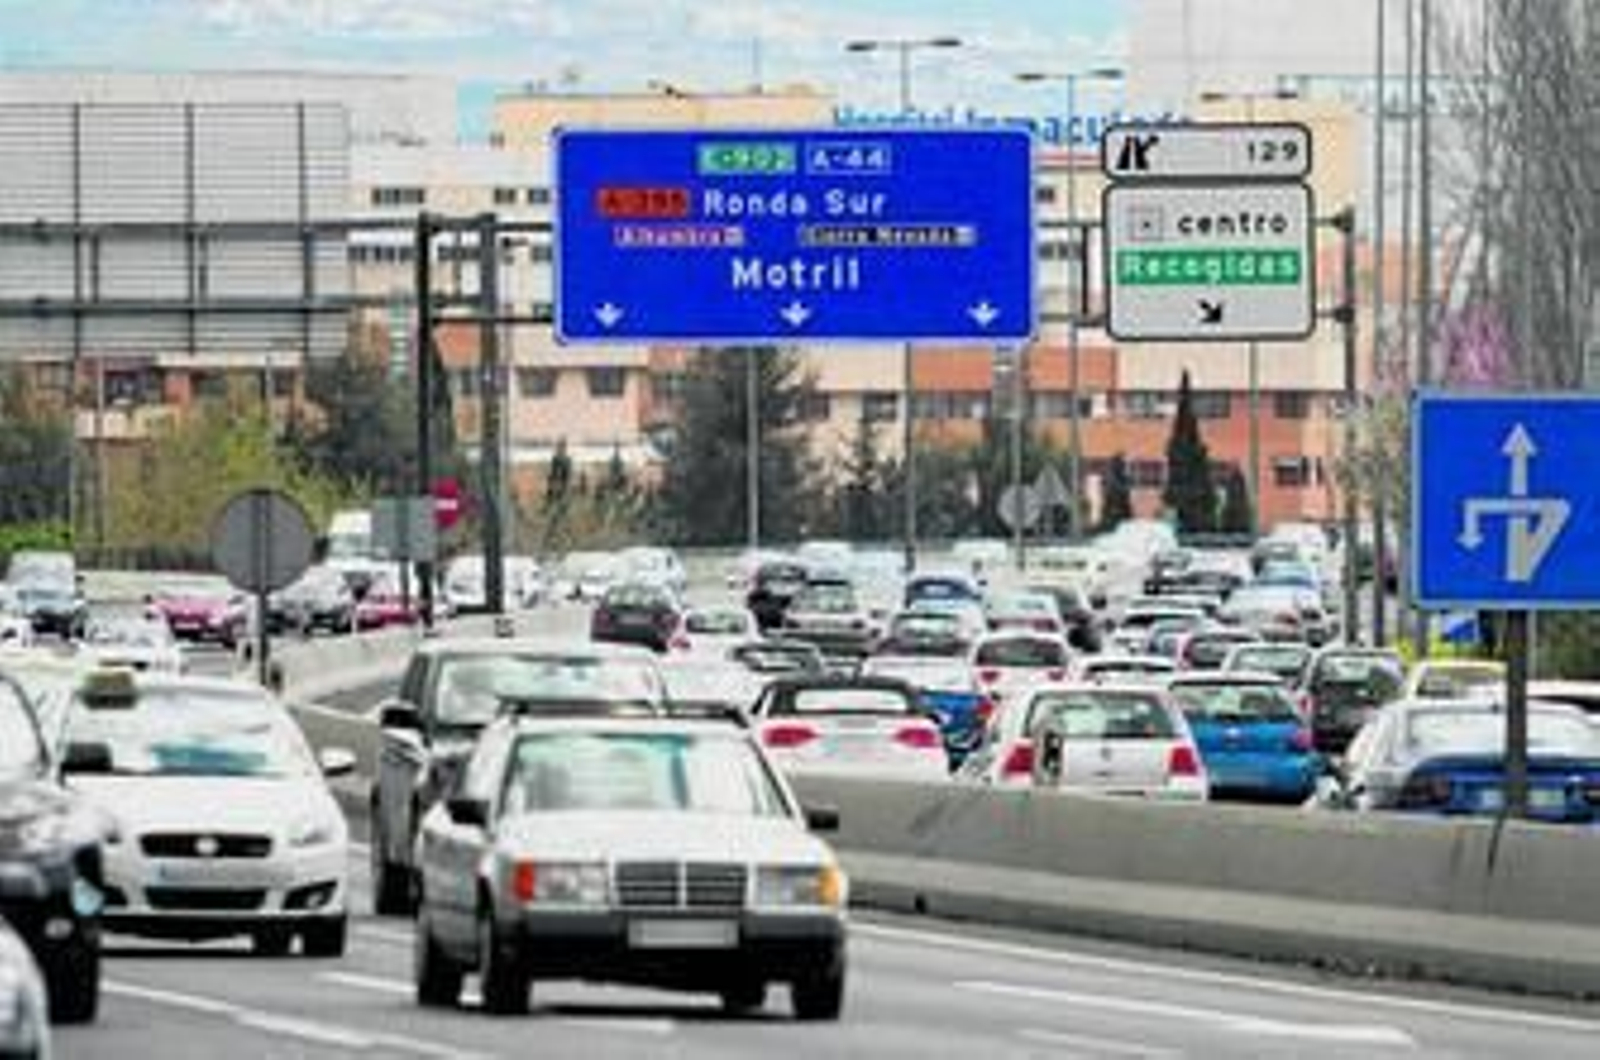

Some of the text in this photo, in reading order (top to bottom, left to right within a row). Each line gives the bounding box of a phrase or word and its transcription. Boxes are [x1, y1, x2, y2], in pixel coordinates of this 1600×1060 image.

[813, 149, 883, 168] A-44
[1247, 139, 1299, 162] 129
[704, 188, 807, 217] Ronda
[825, 188, 886, 216] Sur
[1177, 213, 1288, 234] centro
[732, 258, 860, 290] Motril
[1121, 254, 1299, 281] Recogidas
